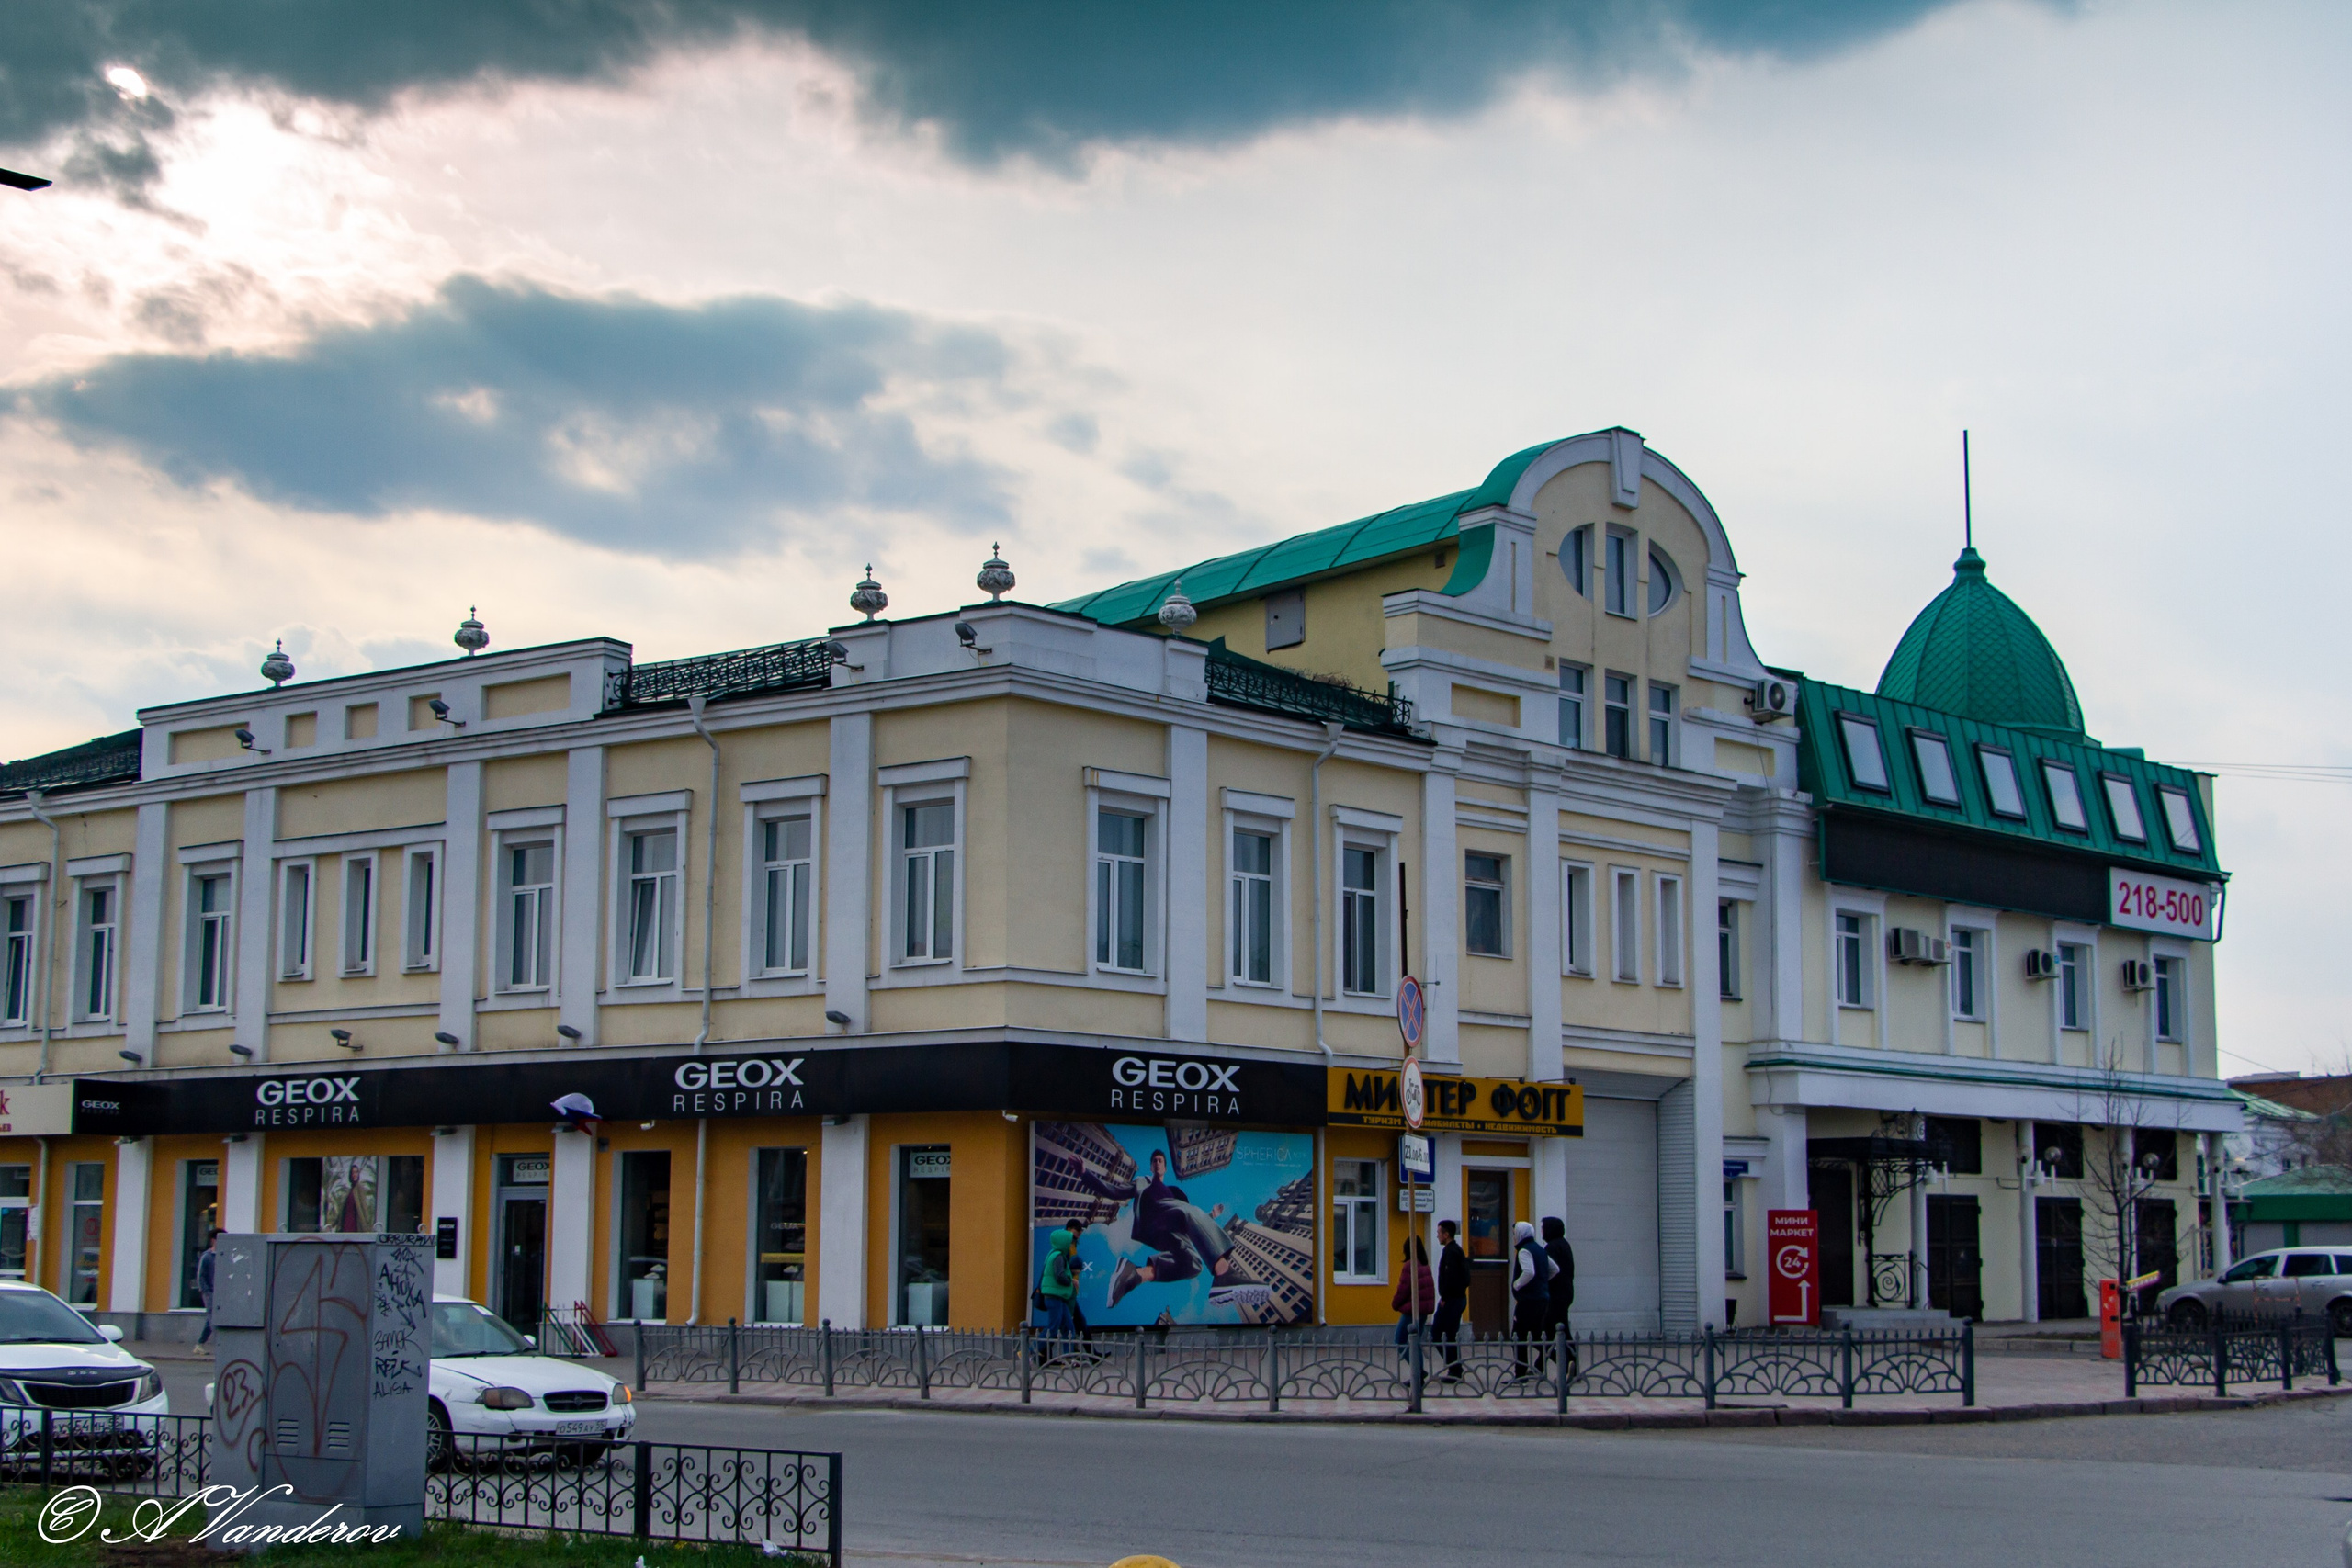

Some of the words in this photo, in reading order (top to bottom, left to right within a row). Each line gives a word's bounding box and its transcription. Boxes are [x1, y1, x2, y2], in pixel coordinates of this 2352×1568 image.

[2118, 881, 2203, 927] 218-500
[674, 1058, 805, 1090] GEOX
[1112, 1056, 1241, 1093] GEOX
[256, 1077, 361, 1106] GEOX
[673, 1089, 804, 1111] RESPIRA
[1111, 1089, 1240, 1115] RESPIRA
[1344, 1072, 1477, 1116] МИТЕР
[1490, 1083, 1571, 1122] ФОГГ
[81, 1100, 120, 1110] GEOX
[255, 1105, 359, 1125] RESPIRA
[1363, 1115, 1402, 1126] ТУРИЗМ
[1485, 1122, 1558, 1134] НЕДВИЖИМОСТЬ
[1774, 1216, 1808, 1225] МИНИ
[1770, 1228, 1814, 1237] МАРКЕТ
[1783, 1256, 1801, 1268] 24
